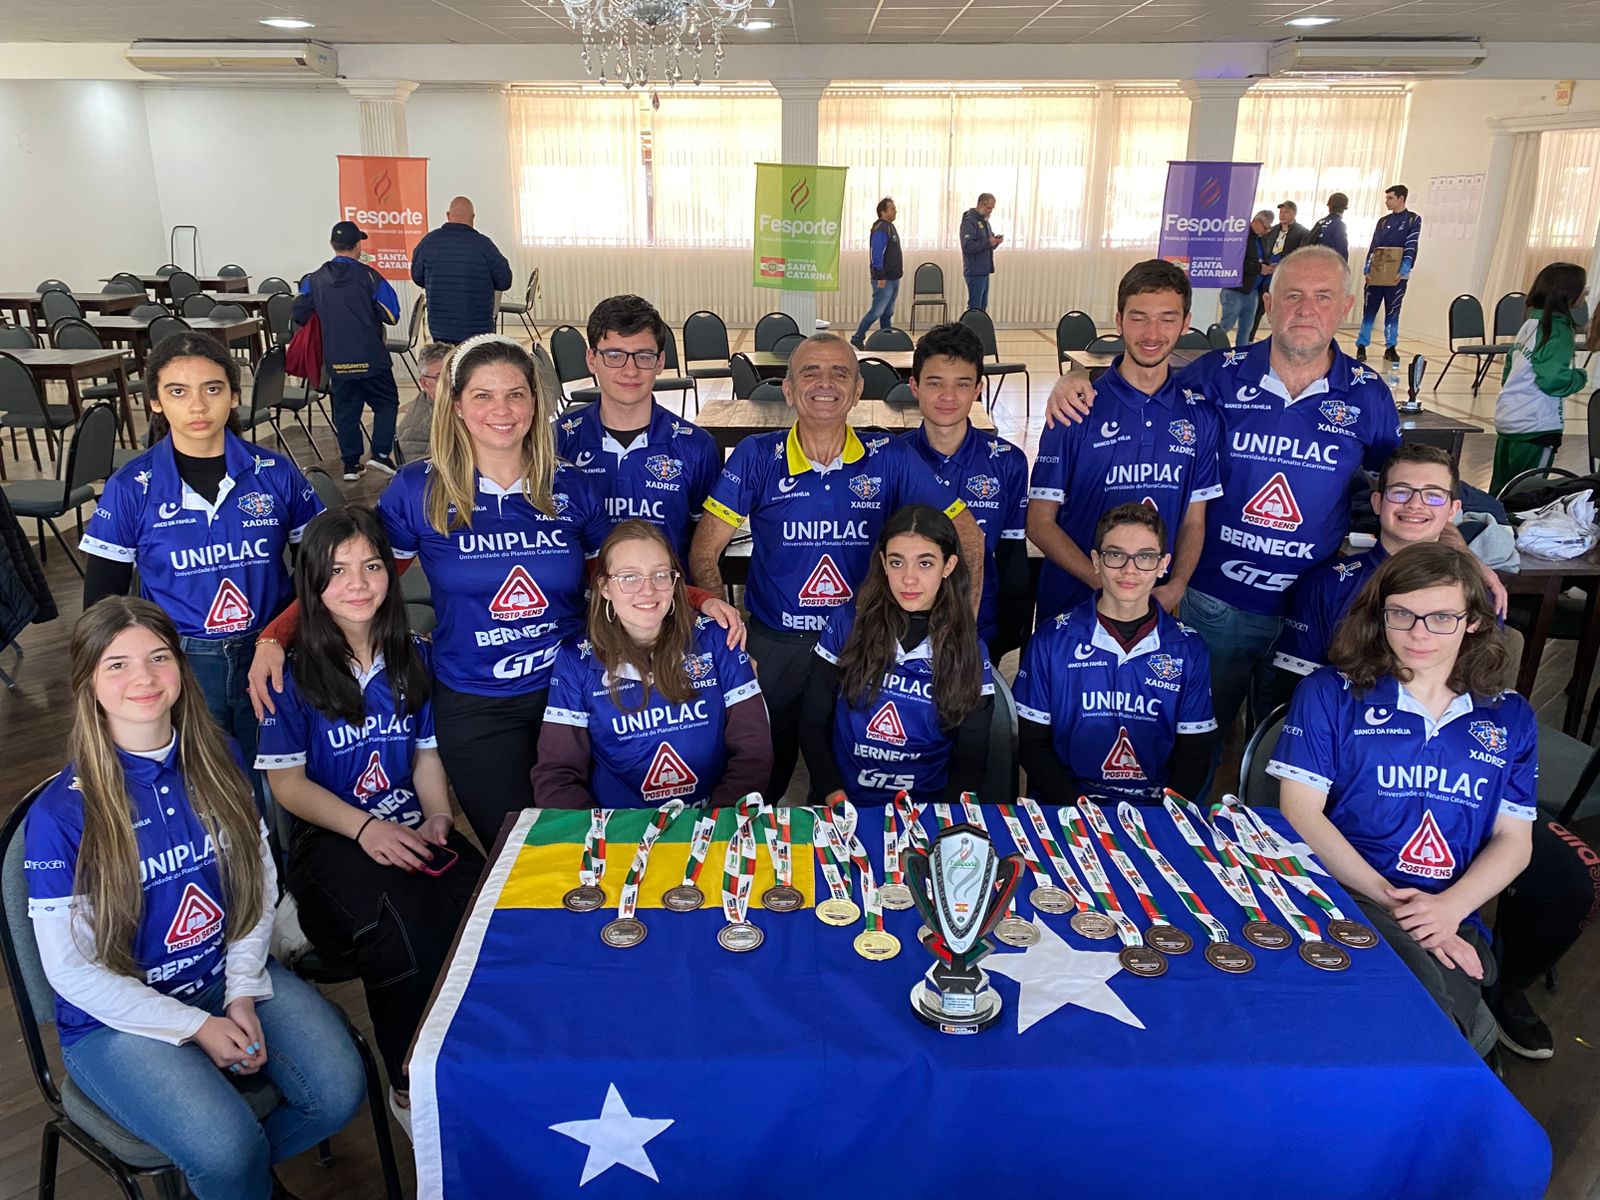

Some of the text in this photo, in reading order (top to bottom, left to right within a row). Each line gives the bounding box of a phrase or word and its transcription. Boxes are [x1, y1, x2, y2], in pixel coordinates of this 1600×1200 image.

[344, 206, 423, 228] Fesporte
[760, 214, 838, 238] Fesporte
[1164, 214, 1246, 236] Fesporte
[377, 253, 409, 261] SANTA
[377, 261, 411, 269] CATARI
[1191, 261, 1222, 269] SANTA
[786, 263, 817, 272] SANTA
[786, 271, 833, 281] CATARINA
[1190, 269, 1238, 277] CATARINA
[1232, 432, 1339, 465] UNIPLAC
[1230, 452, 1268, 461] Universidade
[1277, 457, 1301, 467] Planalto
[1301, 461, 1336, 472] Catarinense
[645, 480, 680, 491] XADREZ
[605, 497, 665, 519] IPLAC
[850, 501, 881, 509] XADREZ
[966, 500, 1000, 509] XADREZ
[242, 518, 279, 528] XADREZ
[783, 520, 869, 540] UNIPLAC
[1243, 515, 1296, 531] POSTO SENS
[459, 529, 568, 553] UNIPLAC
[1220, 524, 1315, 560] BERNECK
[170, 538, 270, 570] UNIPLAC
[459, 552, 500, 560] Universidade
[1220, 559, 1299, 592] GTS
[801, 597, 849, 606] POSTO SENS
[493, 608, 543, 620] POSTO SENS
[782, 611, 830, 631] BERN
[475, 619, 559, 647] BERNECK
[492, 639, 563, 679] GTS
[882, 673, 932, 699] IPLAC
[1144, 677, 1181, 692] XADREZ
[1082, 691, 1162, 716] UNIPLAC
[612, 700, 708, 735] UNIPLAC
[1386, 727, 1411, 735] FAMÍLIA
[857, 768, 915, 791] GTS
[1377, 765, 1489, 800] UNIPLAC
[645, 785, 694, 800] POSTO SENS
[1399, 862, 1432, 876] POSTO
[170, 921, 220, 952] POSTO SENS
